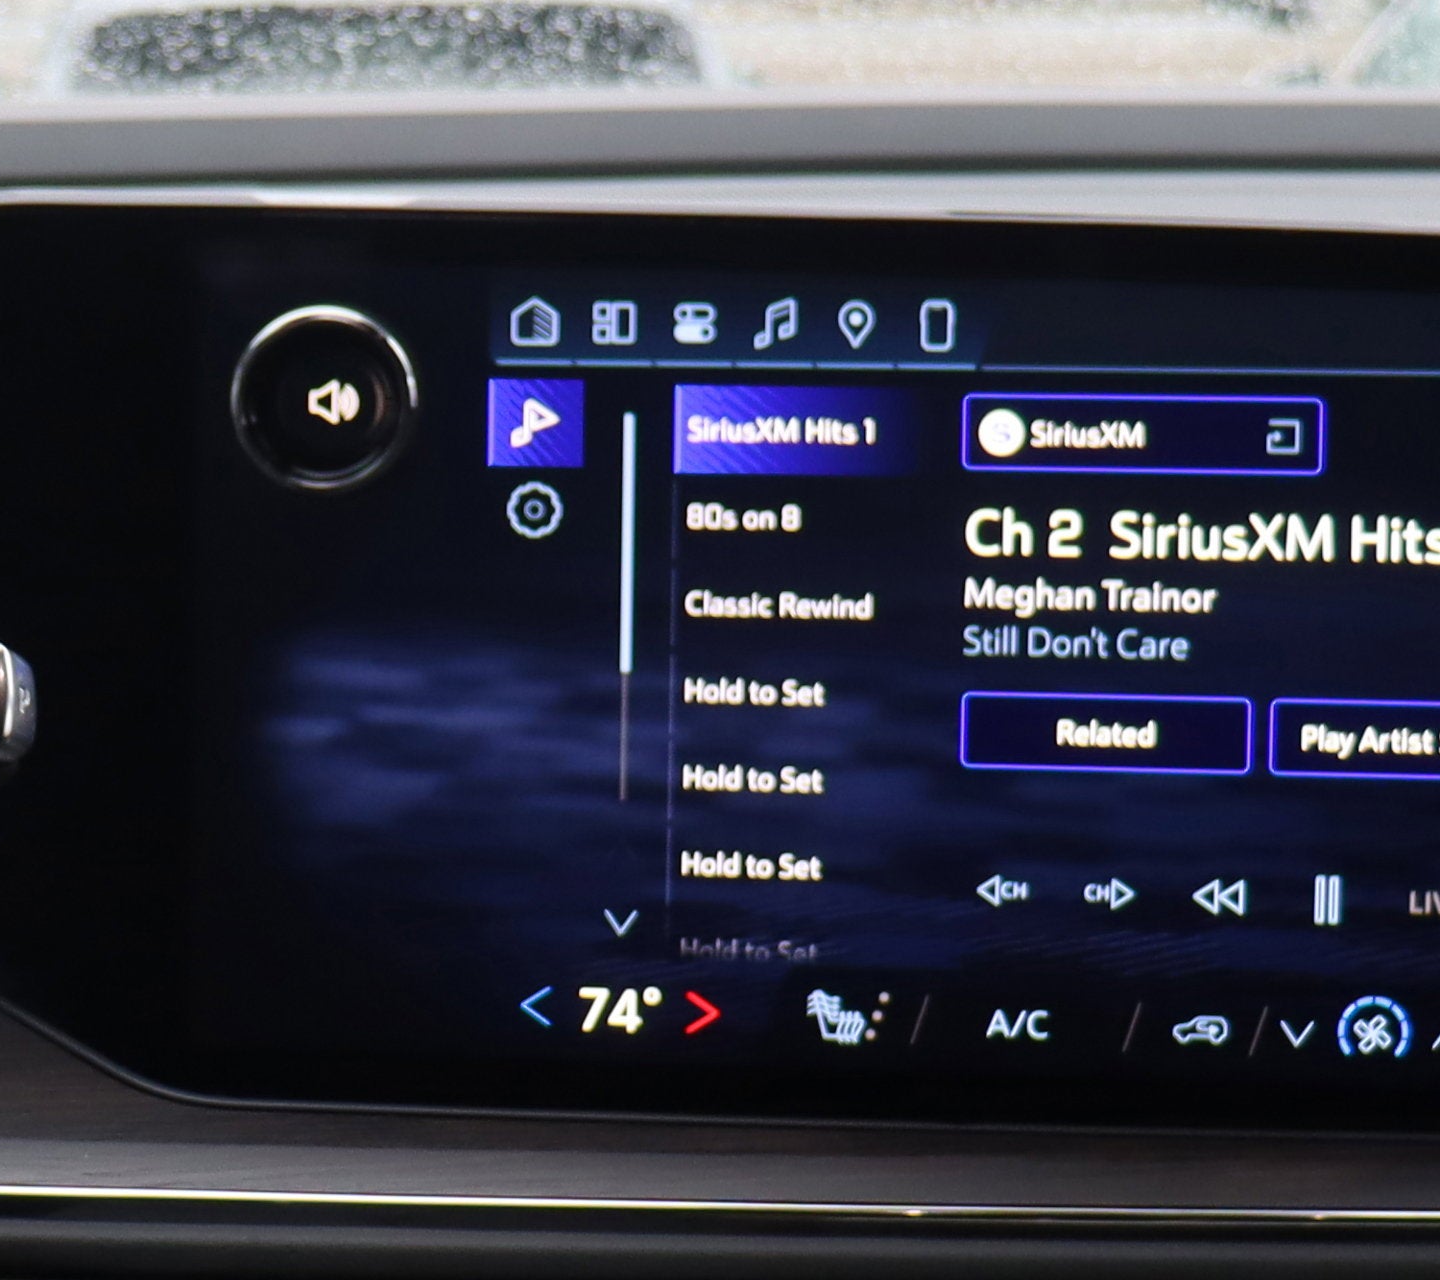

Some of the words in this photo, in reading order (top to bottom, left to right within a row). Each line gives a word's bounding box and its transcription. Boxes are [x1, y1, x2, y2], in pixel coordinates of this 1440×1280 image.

[687, 416, 801, 444] SiriusXM
[805, 417, 858, 445] Hits
[862, 417, 877, 445] 1
[1029, 419, 1147, 449] SiriusXM
[686, 502, 738, 531] 80s
[742, 509, 777, 531] on
[781, 503, 801, 532] 8
[965, 506, 1034, 558] Ch
[1048, 508, 1084, 559] 2
[1108, 509, 1336, 562] SiriusXM
[685, 589, 773, 618] Classic
[778, 591, 874, 621] Rewind
[964, 576, 1097, 618] Meghan
[1101, 578, 1218, 613] Trainor
[963, 624, 1019, 657] Still
[1027, 626, 1109, 659] Don't
[1116, 628, 1190, 661] Care
[684, 676, 745, 706] Hold
[749, 680, 778, 706] to
[781, 678, 826, 707] Set
[1056, 718, 1157, 749] Related
[1300, 723, 1357, 760] Play
[1358, 725, 1434, 755] Artist
[682, 763, 743, 793] Hold
[747, 767, 777, 793] to
[779, 765, 825, 794] Set
[680, 850, 742, 879] Hold
[745, 854, 775, 880] to
[778, 852, 823, 881] Set
[1000, 880, 1029, 900] CH
[1083, 883, 1110, 903] CH
[680, 937, 738, 961] Hold
[744, 941, 770, 961] to
[777, 940, 819, 962] Set
[577, 986, 663, 1034] 74°
[985, 1009, 1049, 1040] A/C
